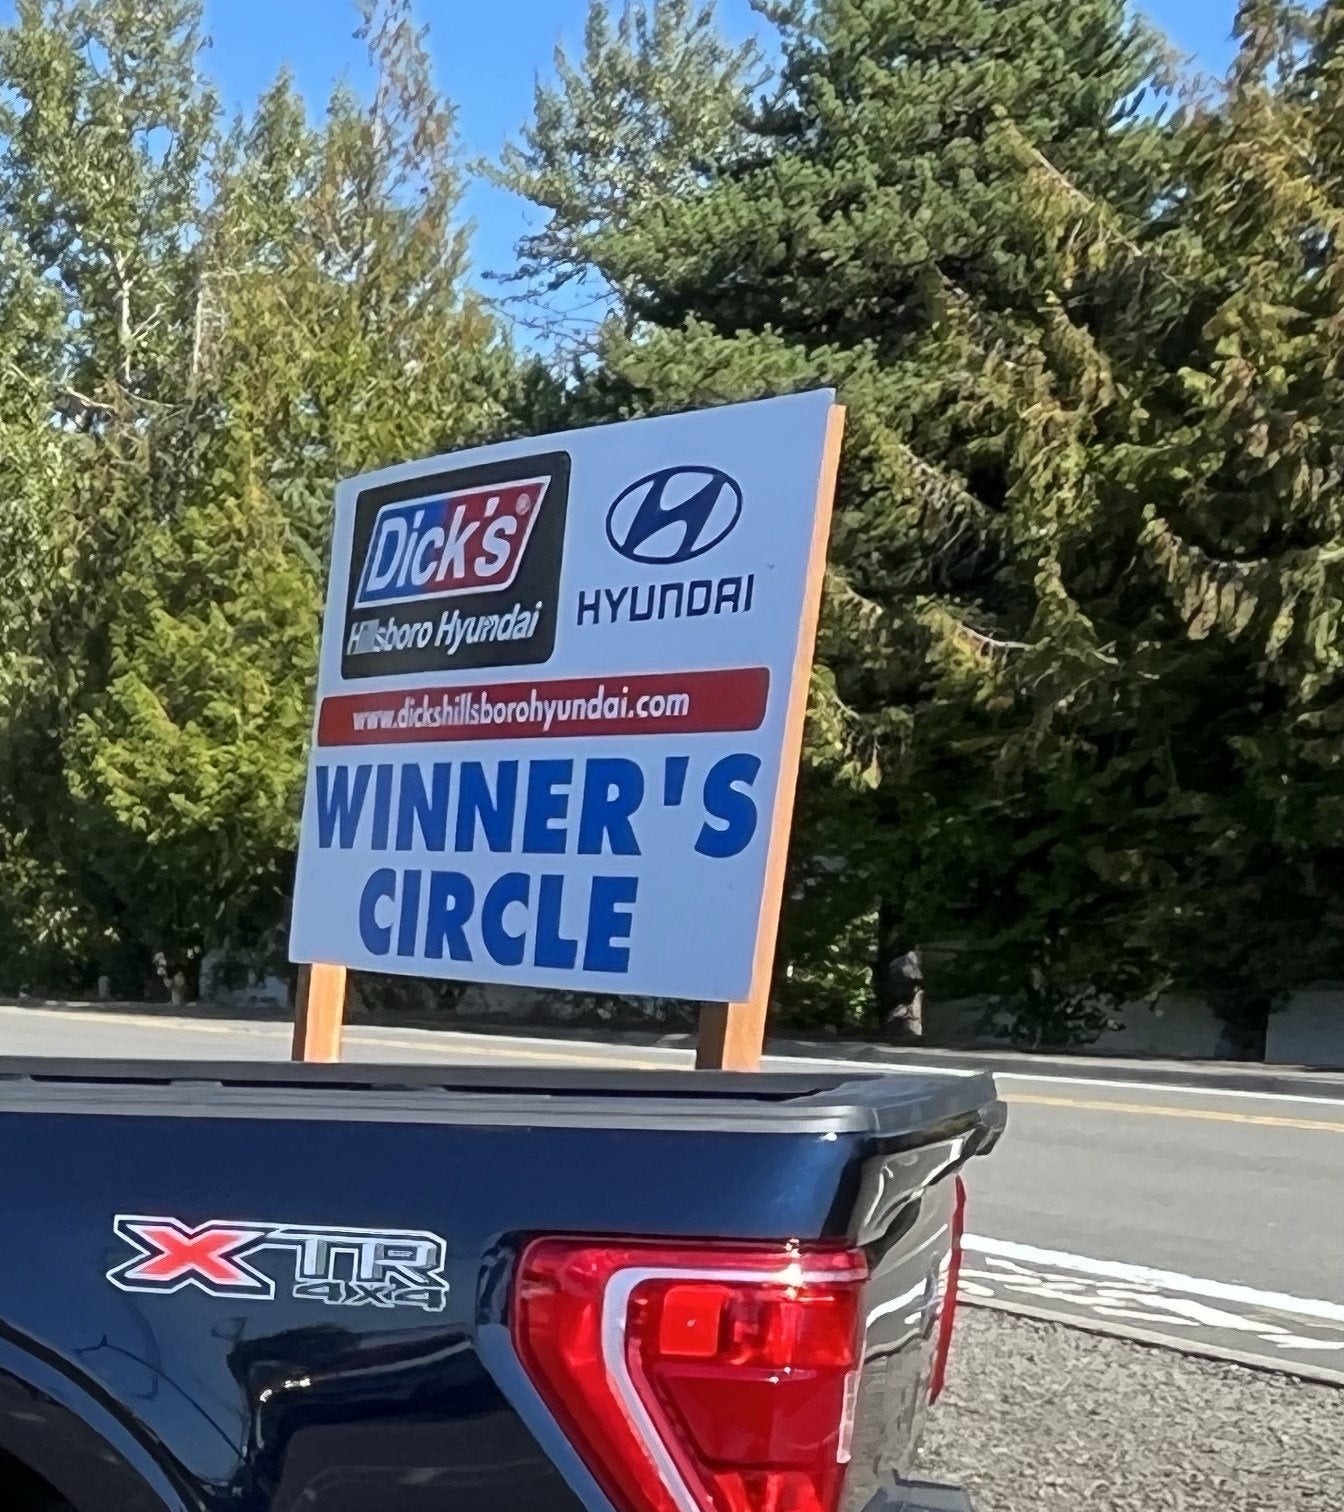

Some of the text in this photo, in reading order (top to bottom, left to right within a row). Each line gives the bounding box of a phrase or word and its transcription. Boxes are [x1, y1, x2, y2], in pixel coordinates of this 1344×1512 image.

[365, 497, 518, 592] Dick's
[346, 600, 543, 656] Hsboro Hyundai
[578, 574, 754, 626] HYUNDAI
[352, 684, 690, 732] www.dickshillsborohyundai.com
[315, 752, 762, 859] WINNER'S
[358, 867, 639, 974] CIRCLE
